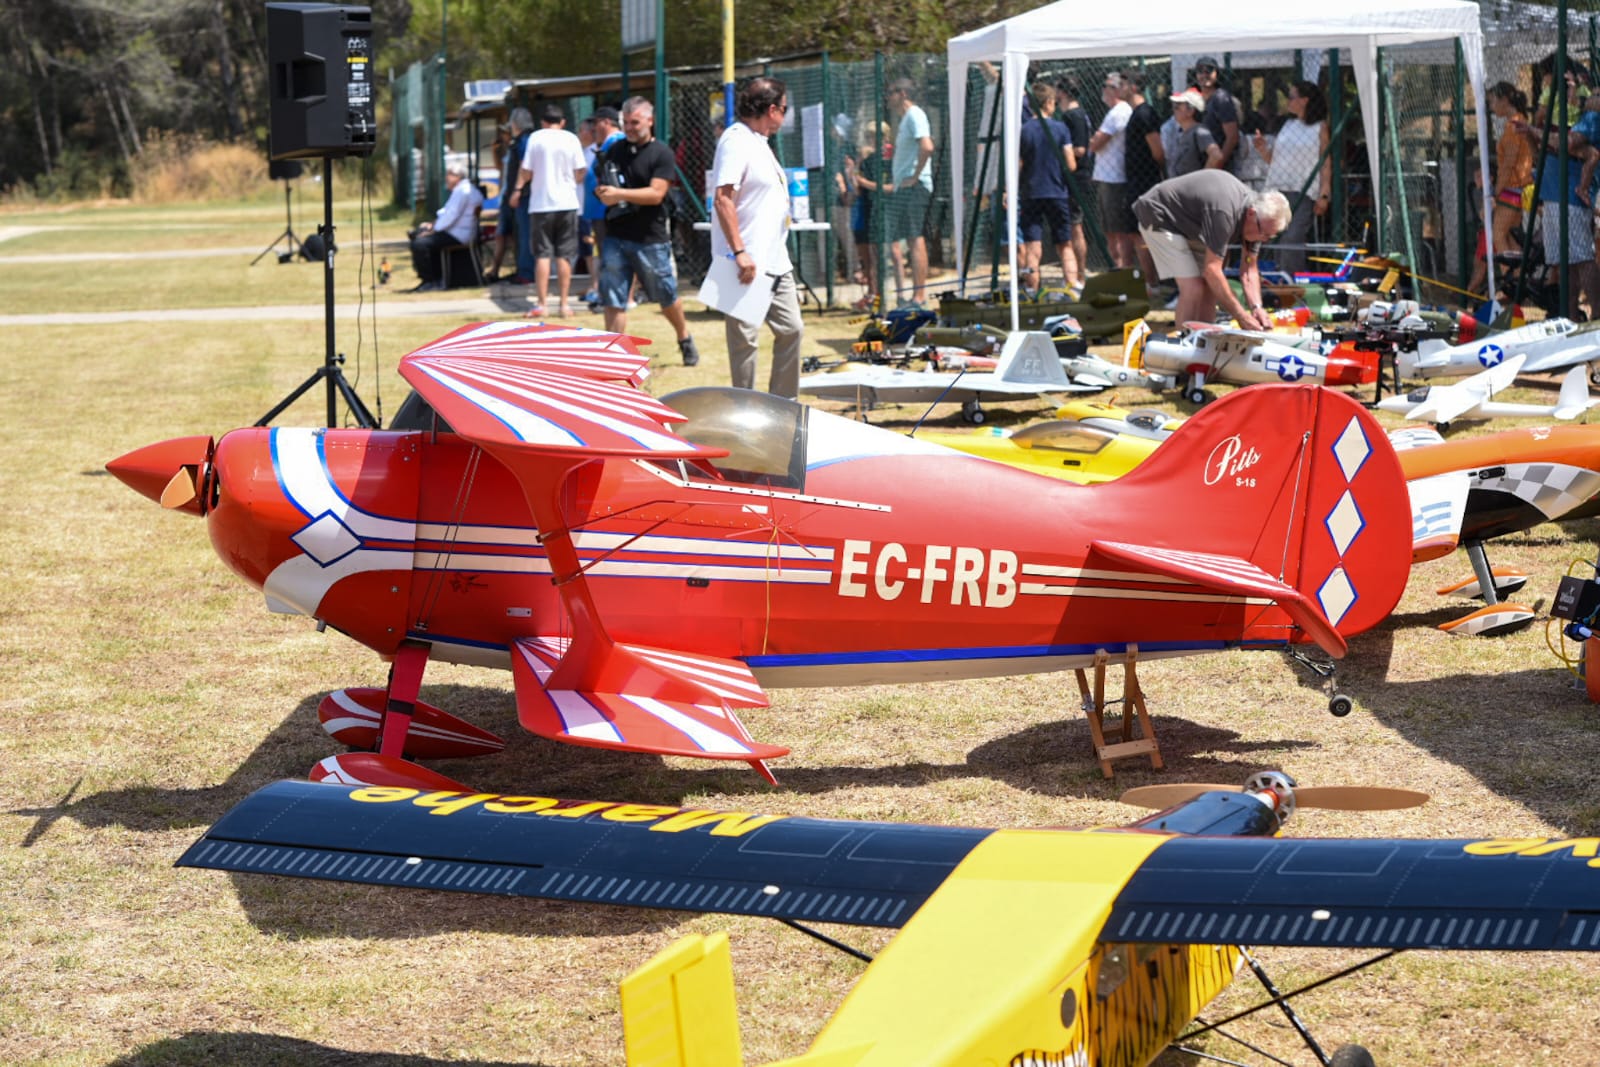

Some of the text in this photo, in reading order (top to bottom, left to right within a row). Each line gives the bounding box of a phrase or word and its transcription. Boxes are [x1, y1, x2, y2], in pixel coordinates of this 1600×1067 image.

[1204, 433, 1261, 486] Pitts
[838, 539, 1019, 608] EC-FRB
[349, 786, 780, 837] Marche
